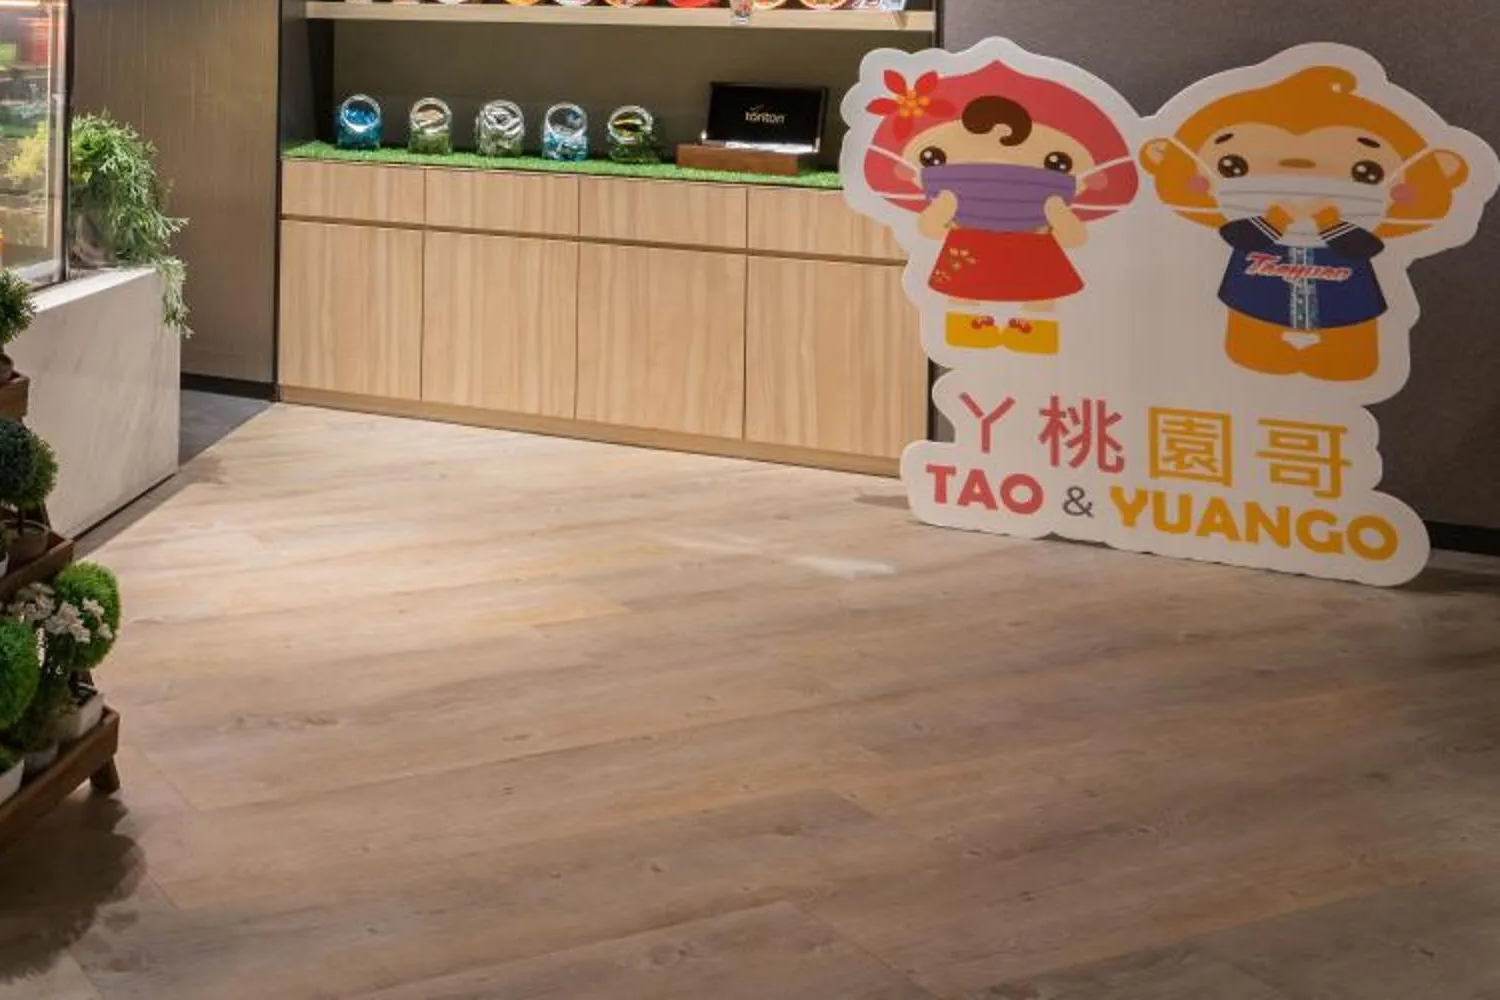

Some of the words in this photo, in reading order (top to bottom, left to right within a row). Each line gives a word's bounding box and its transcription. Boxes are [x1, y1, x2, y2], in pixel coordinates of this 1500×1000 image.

[926, 464, 1045, 515] TAO
[1062, 485, 1095, 518] &
[1108, 483, 1400, 562] YUANGO
